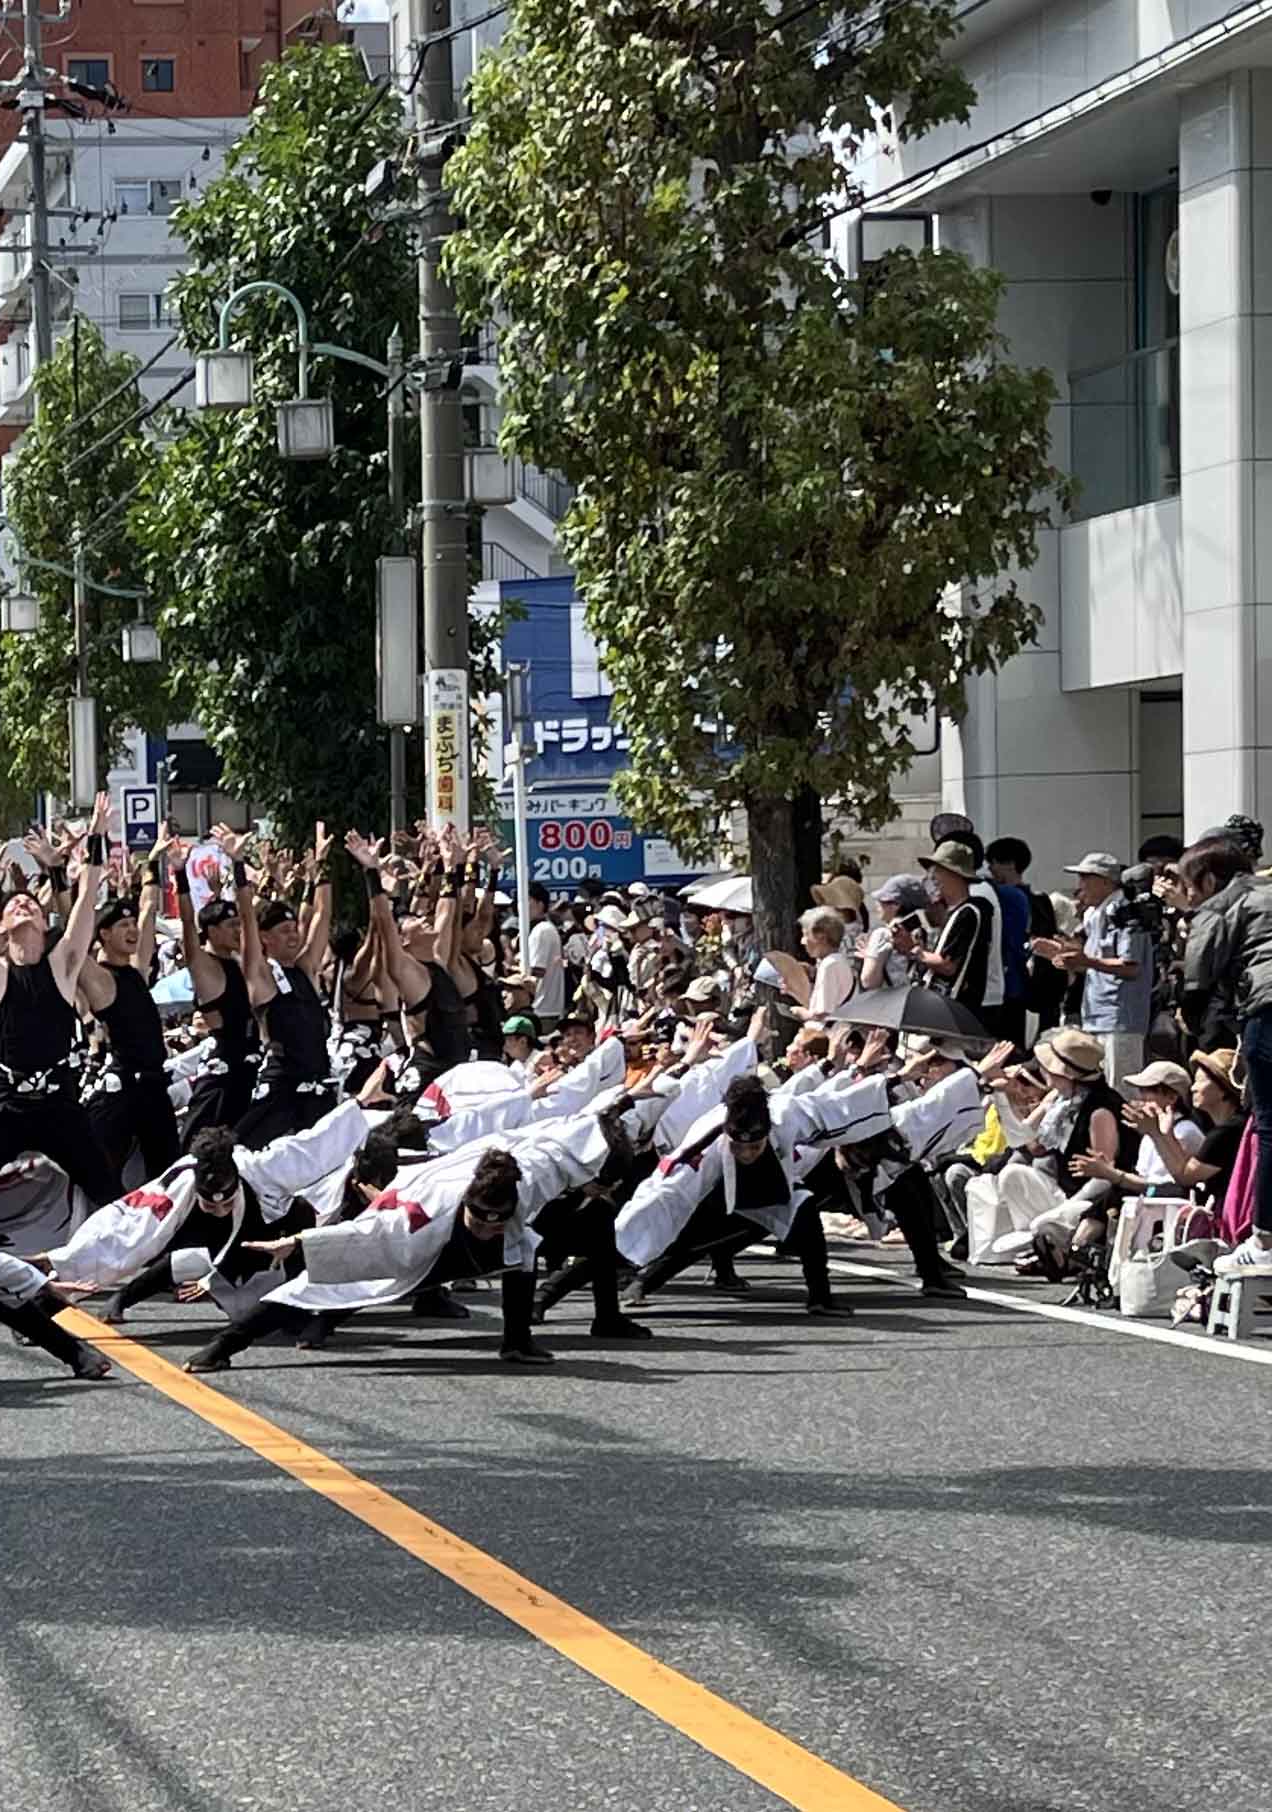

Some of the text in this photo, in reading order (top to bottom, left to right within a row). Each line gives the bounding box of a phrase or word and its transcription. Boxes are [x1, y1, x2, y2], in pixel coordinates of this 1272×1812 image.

[132, 797, 149, 819] P
[539, 819, 632, 851] 800円
[533, 857, 602, 881] 200円
